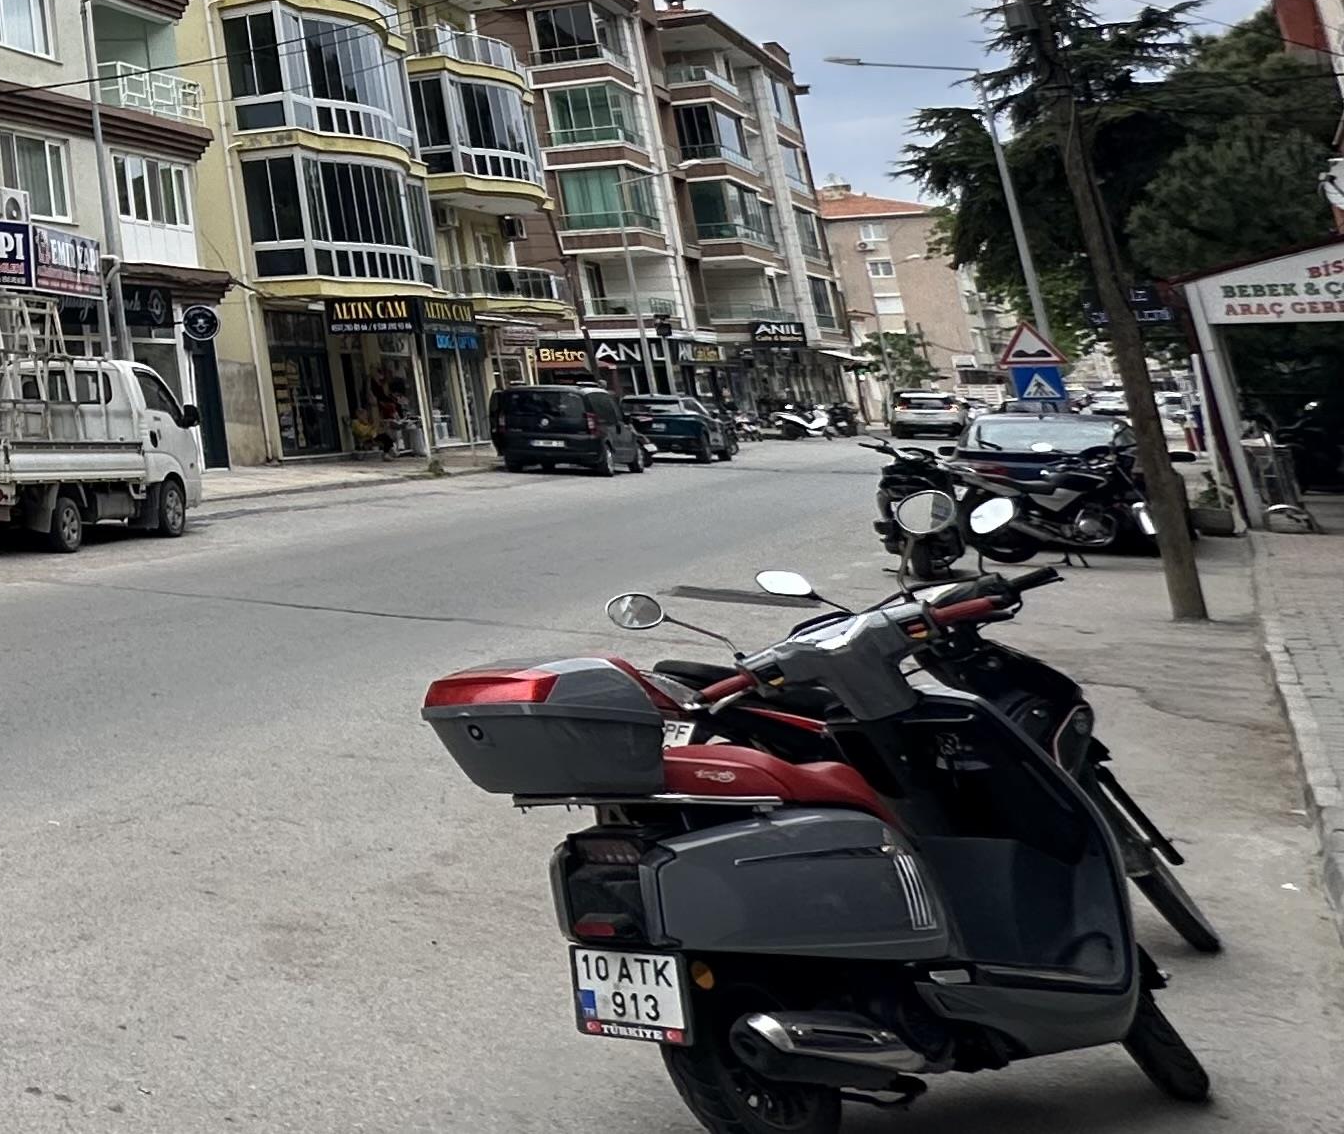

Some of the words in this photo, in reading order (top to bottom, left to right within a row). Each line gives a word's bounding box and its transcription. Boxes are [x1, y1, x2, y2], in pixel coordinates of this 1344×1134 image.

[1220, 283, 1298, 299] BEBEK
[1304, 282, 1320, 296] &
[1324, 281, 1344, 300] Ç
[333, 301, 373, 320] ALTIN
[376, 300, 408, 318] CAM
[424, 301, 452, 320] ALTIN
[452, 304, 472, 322] CAM
[1224, 302, 1284, 319] ARAÇ
[755, 324, 802, 335] ANIL
[539, 348, 586, 362] Bistro
[595, 342, 667, 362] ANL
[581, 953, 608, 982] 10
[617, 957, 673, 988] ATK
[611, 990, 660, 1022] 913
[601, 1023, 663, 1040] TÜRKİYE
